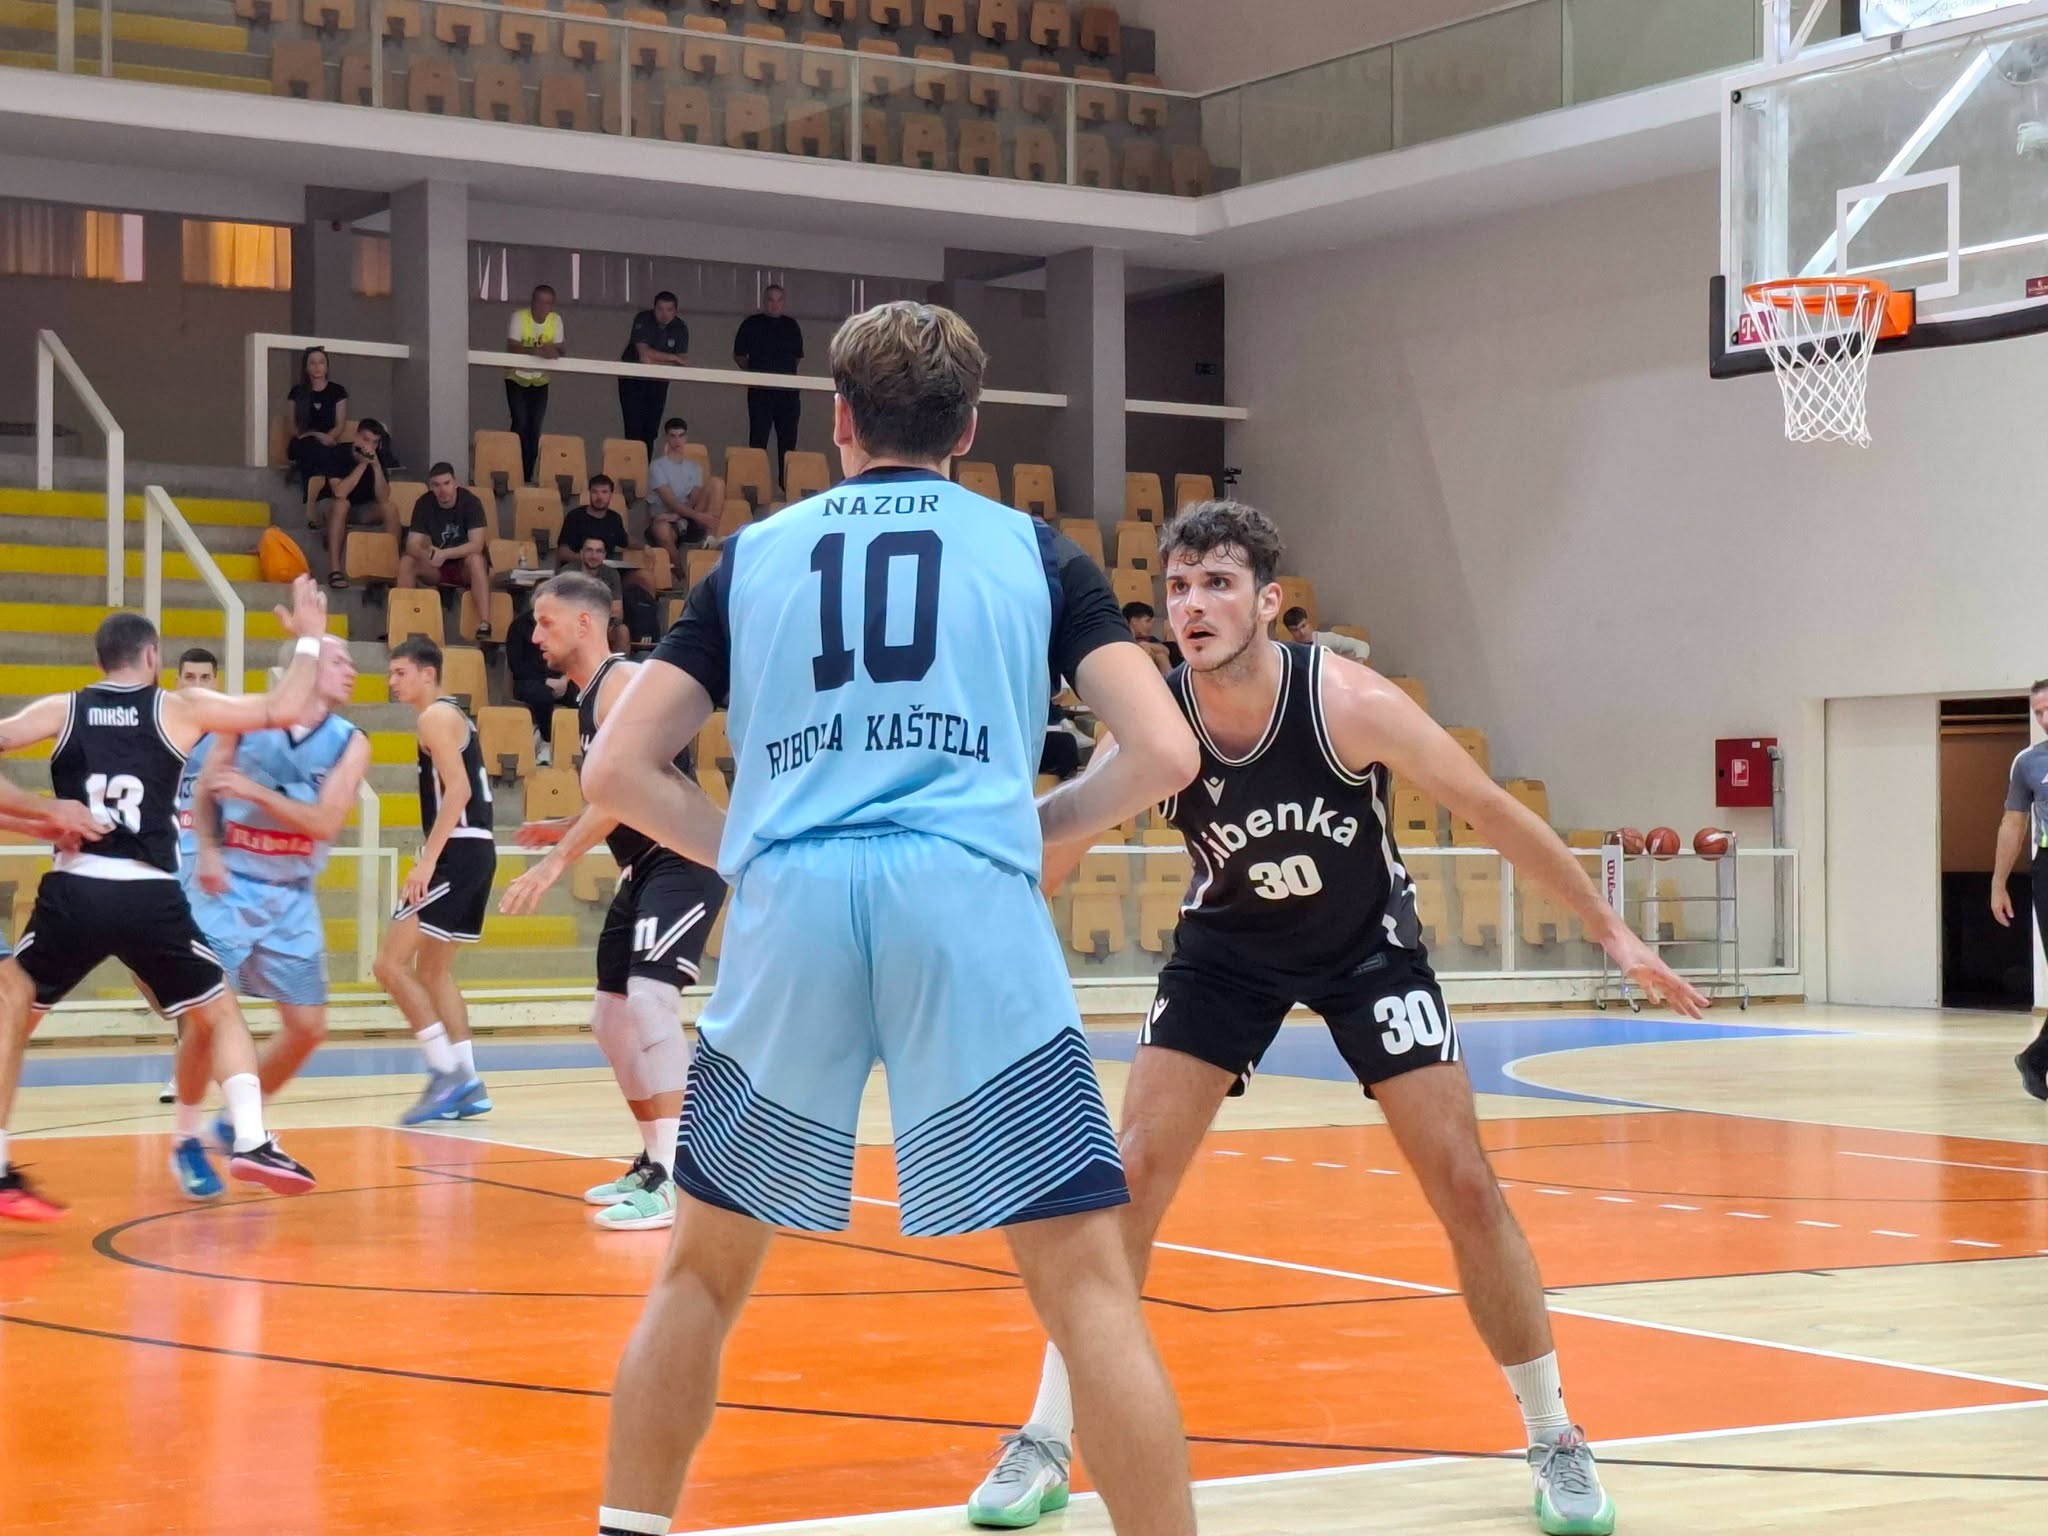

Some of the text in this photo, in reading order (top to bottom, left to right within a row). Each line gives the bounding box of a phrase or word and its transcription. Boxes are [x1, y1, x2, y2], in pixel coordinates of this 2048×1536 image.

[822, 494, 939, 517] NAZOR
[810, 529, 943, 692] 10
[864, 703, 991, 763] KAŠTELA
[1201, 797, 1359, 870] ibenka
[1248, 854, 1323, 900] 30
[633, 916, 660, 952] 11
[1373, 990, 1445, 1056] 30
